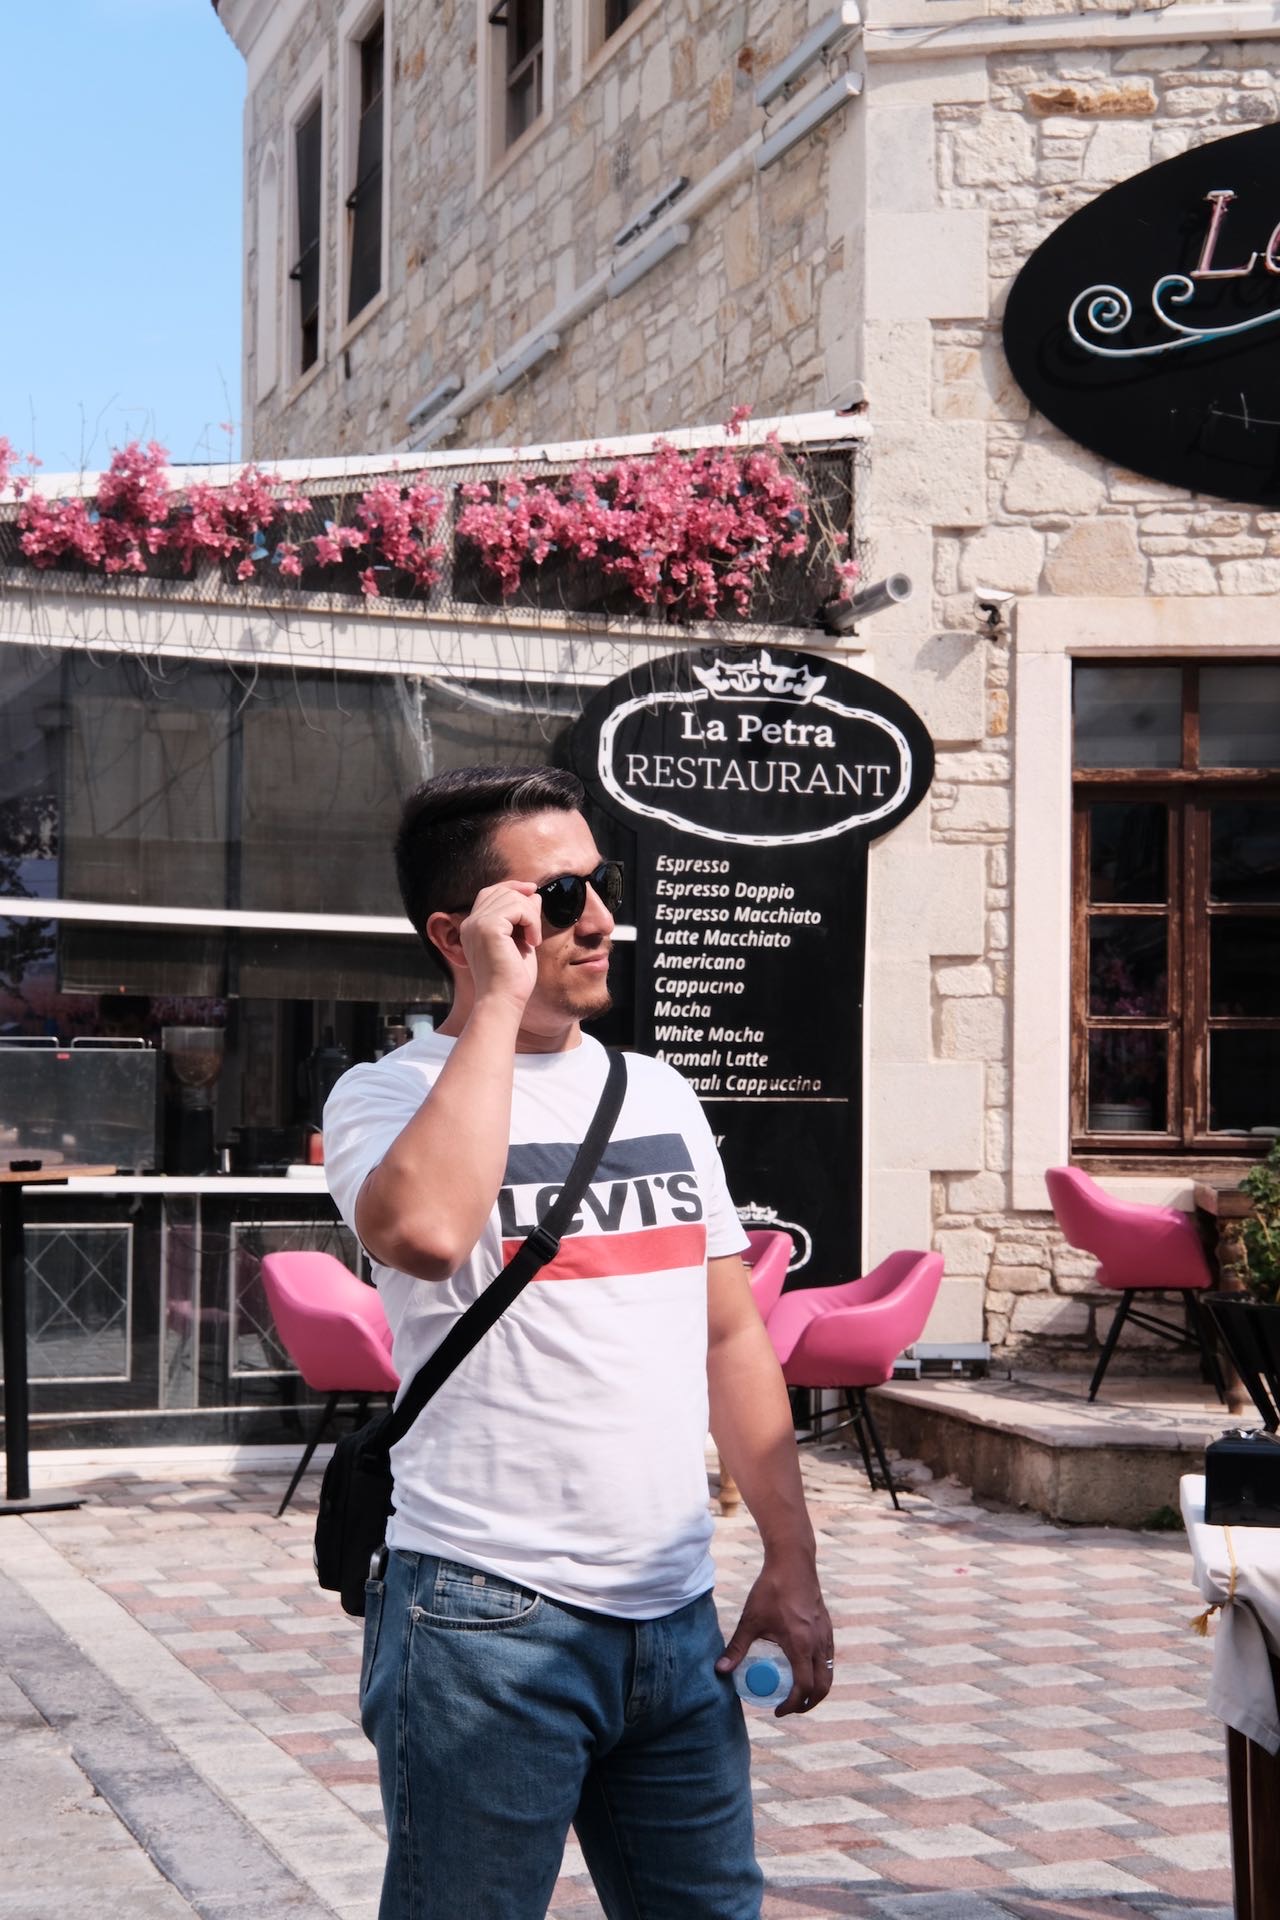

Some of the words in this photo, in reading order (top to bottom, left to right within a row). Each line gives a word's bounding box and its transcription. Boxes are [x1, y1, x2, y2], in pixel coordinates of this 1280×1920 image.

[680, 711, 727, 742] La
[738, 714, 836, 748] Petra
[625, 754, 891, 797] RESTAURANT
[656, 855, 730, 875] Espresso
[656, 880, 730, 900] Espresso
[735, 882, 795, 903] Doppio
[655, 904, 730, 924] Espresso
[734, 906, 821, 924] Macchiato
[655, 928, 699, 945] Latte
[704, 929, 791, 948] Macchiato
[653, 953, 746, 970] Americano
[654, 1001, 711, 1018] Mocha
[655, 1025, 704, 1042] White
[708, 1026, 764, 1043] Mocha
[726, 1051, 768, 1067] Latte
[726, 1075, 821, 1096] Cappuccino
